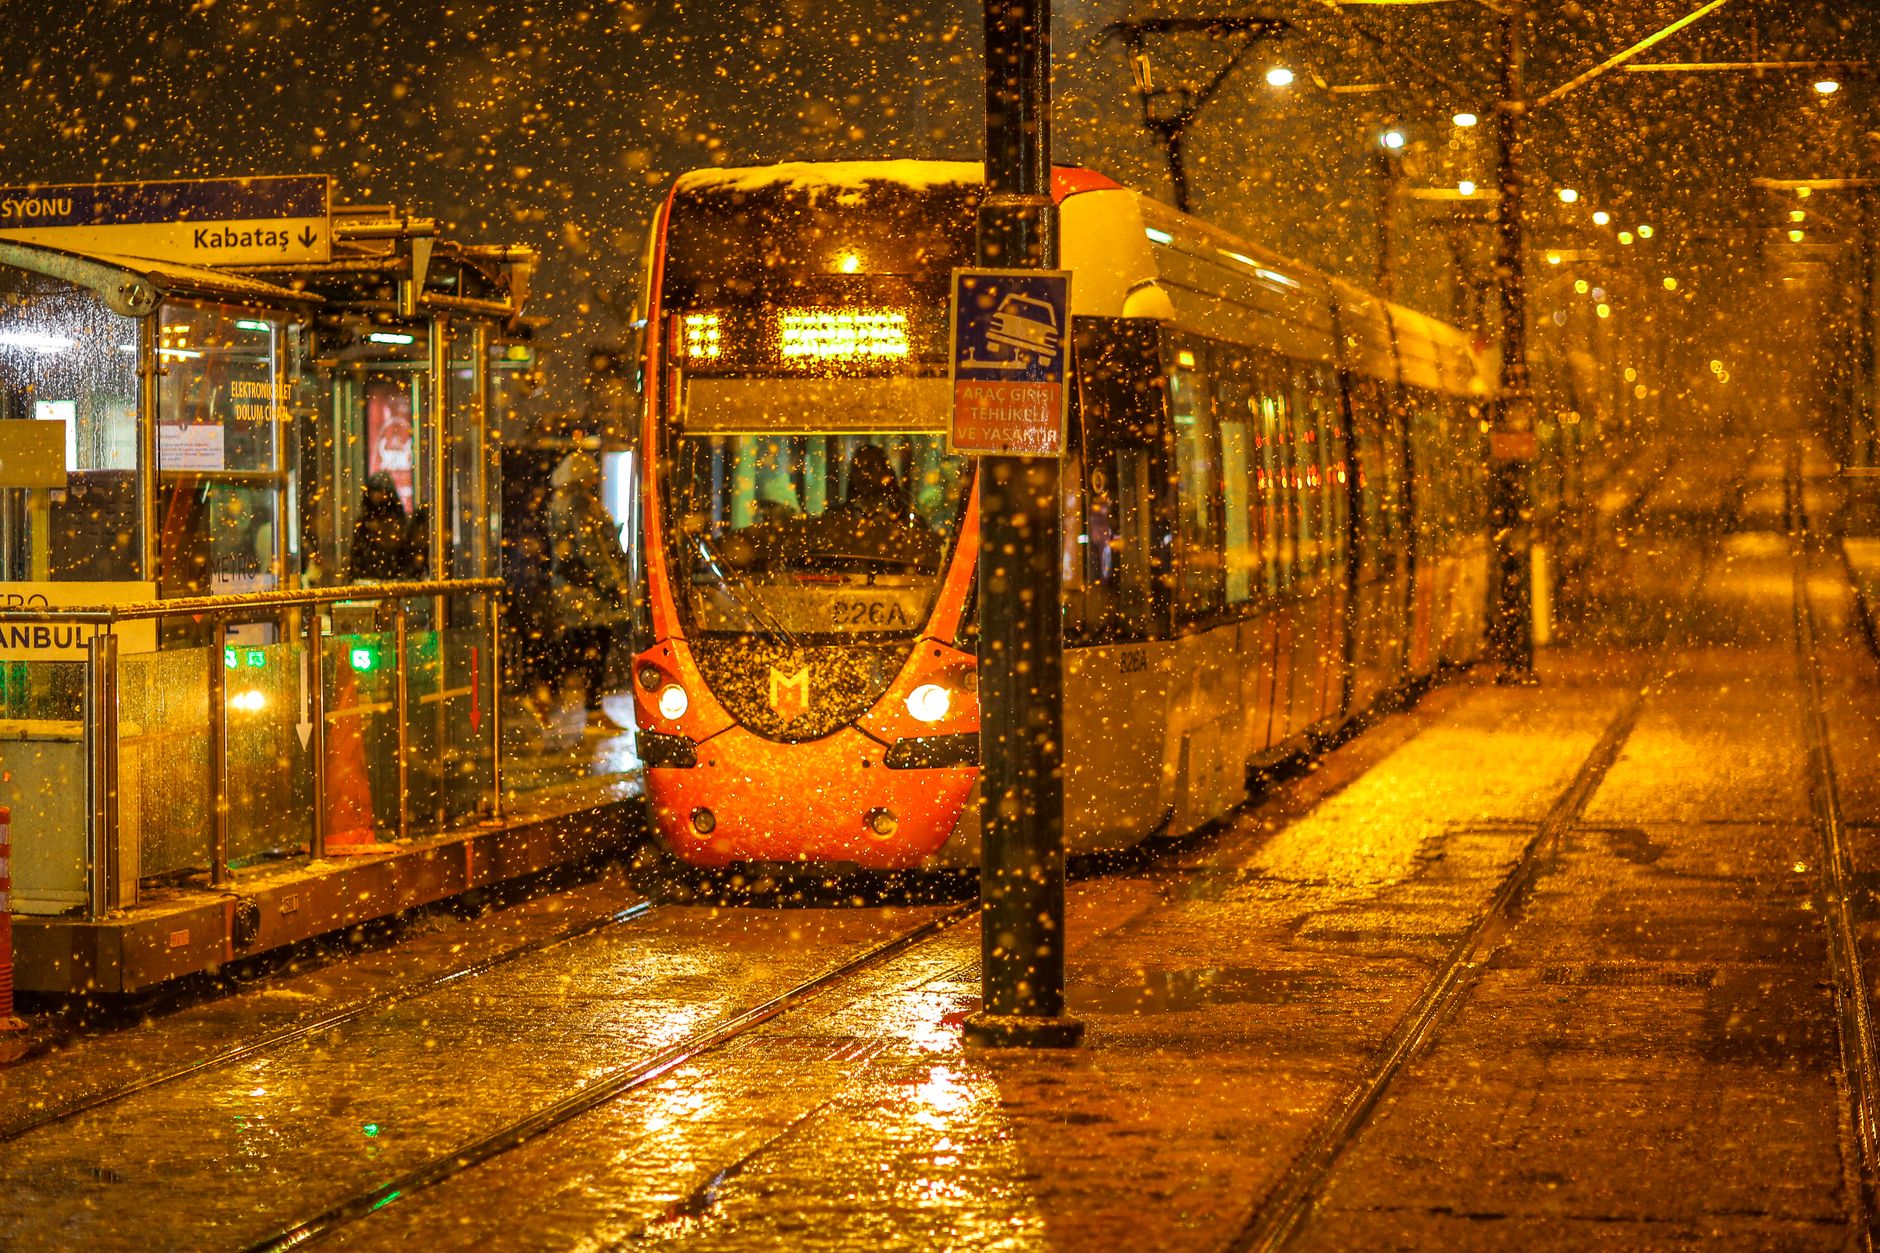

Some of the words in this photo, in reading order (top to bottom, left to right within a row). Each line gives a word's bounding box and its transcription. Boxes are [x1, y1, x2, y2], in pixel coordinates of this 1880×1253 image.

[1, 198, 72, 217] SYONU
[194, 226, 289, 252] Kabataş
[962, 387, 1006, 402] ARAÇ
[236, 404, 263, 421] DOLUM
[957, 427, 976, 440] VE
[833, 602, 906, 625] 826A
[1120, 650, 1147, 673] 826A
